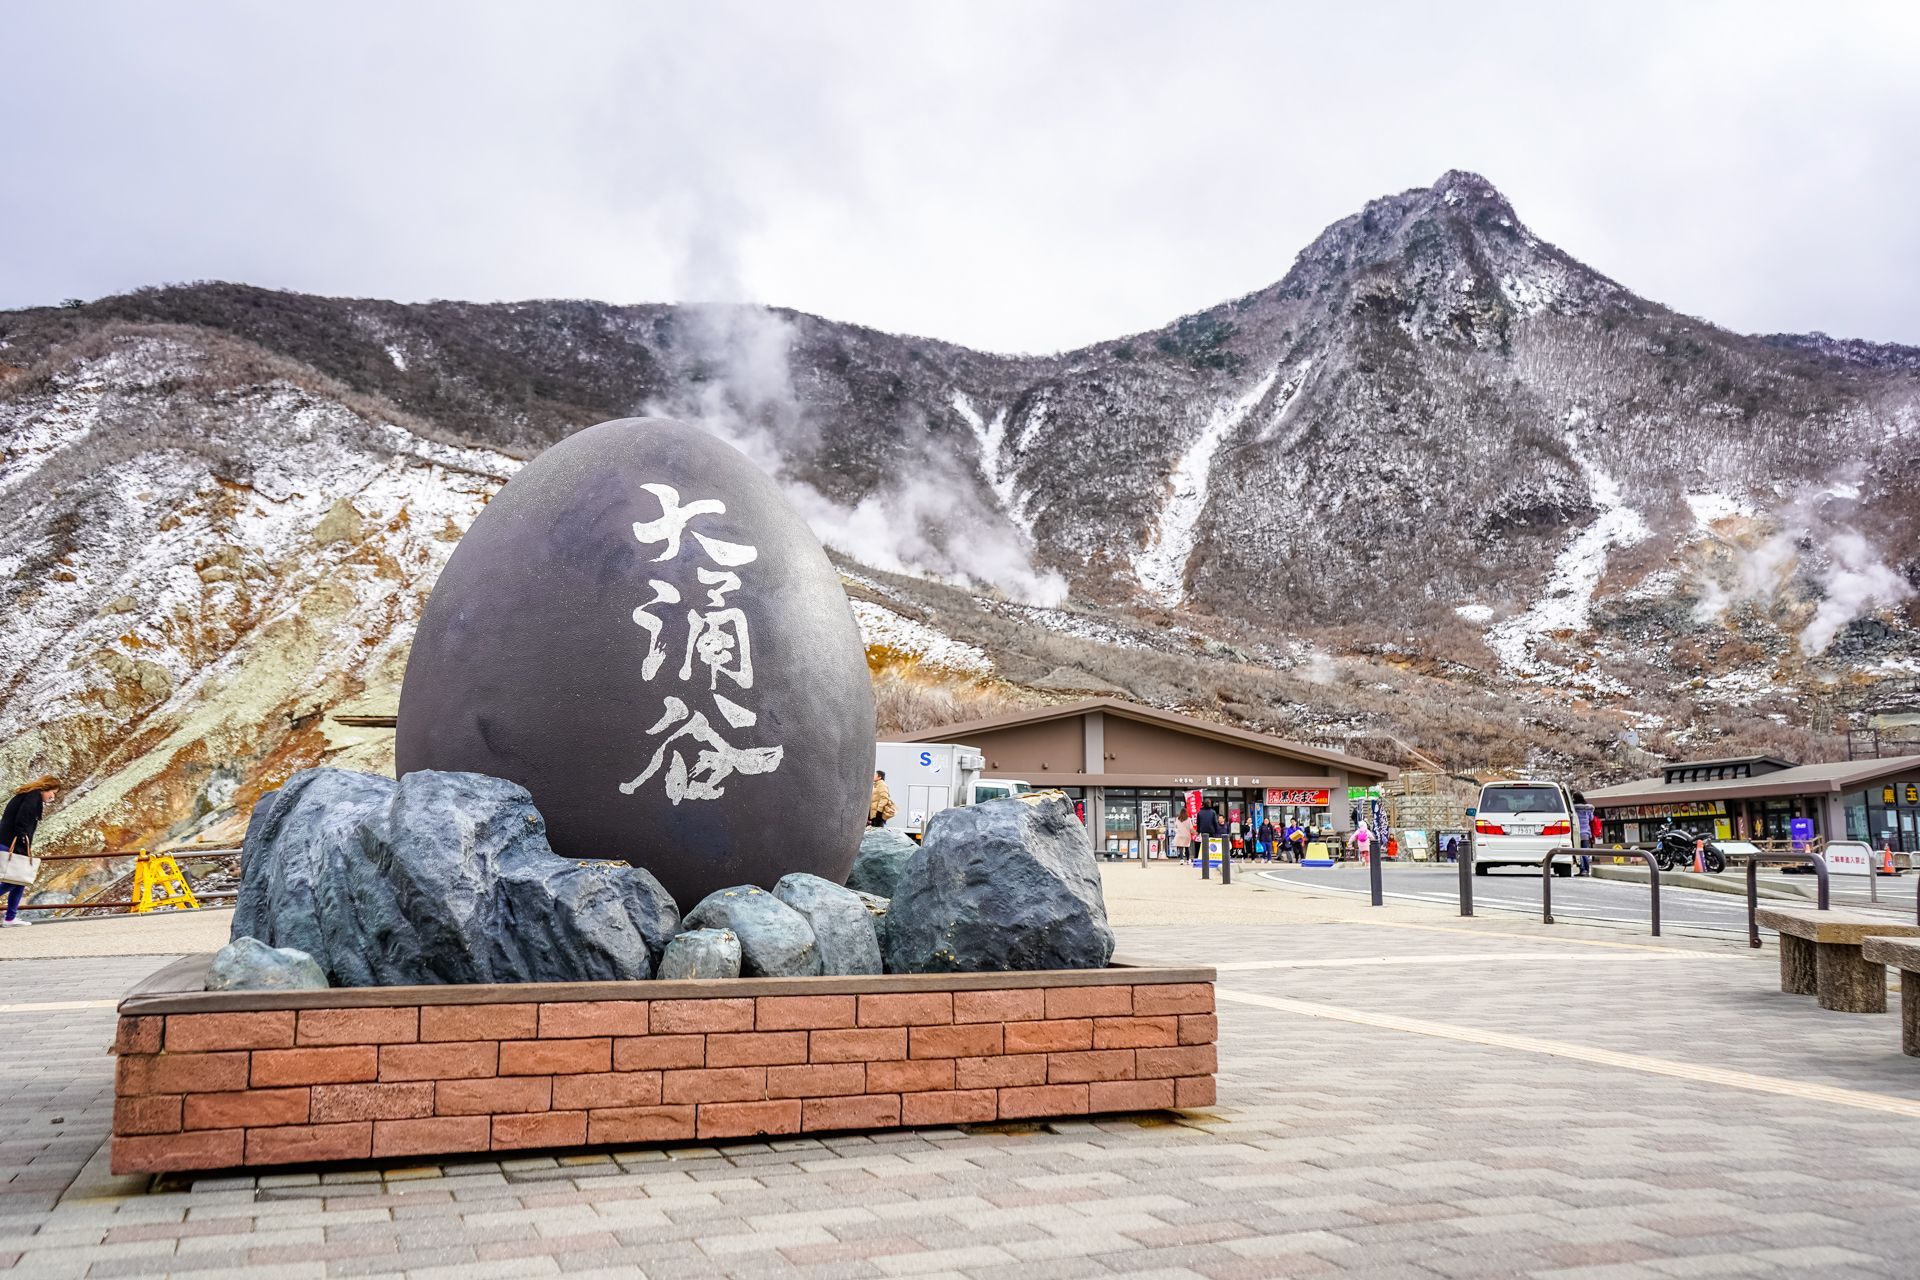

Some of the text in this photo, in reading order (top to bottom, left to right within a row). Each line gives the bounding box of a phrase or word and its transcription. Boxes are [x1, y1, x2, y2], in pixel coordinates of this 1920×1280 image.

[619, 483, 784, 806] 大涌谷
[1280, 790, 1319, 804] 黒たまご
